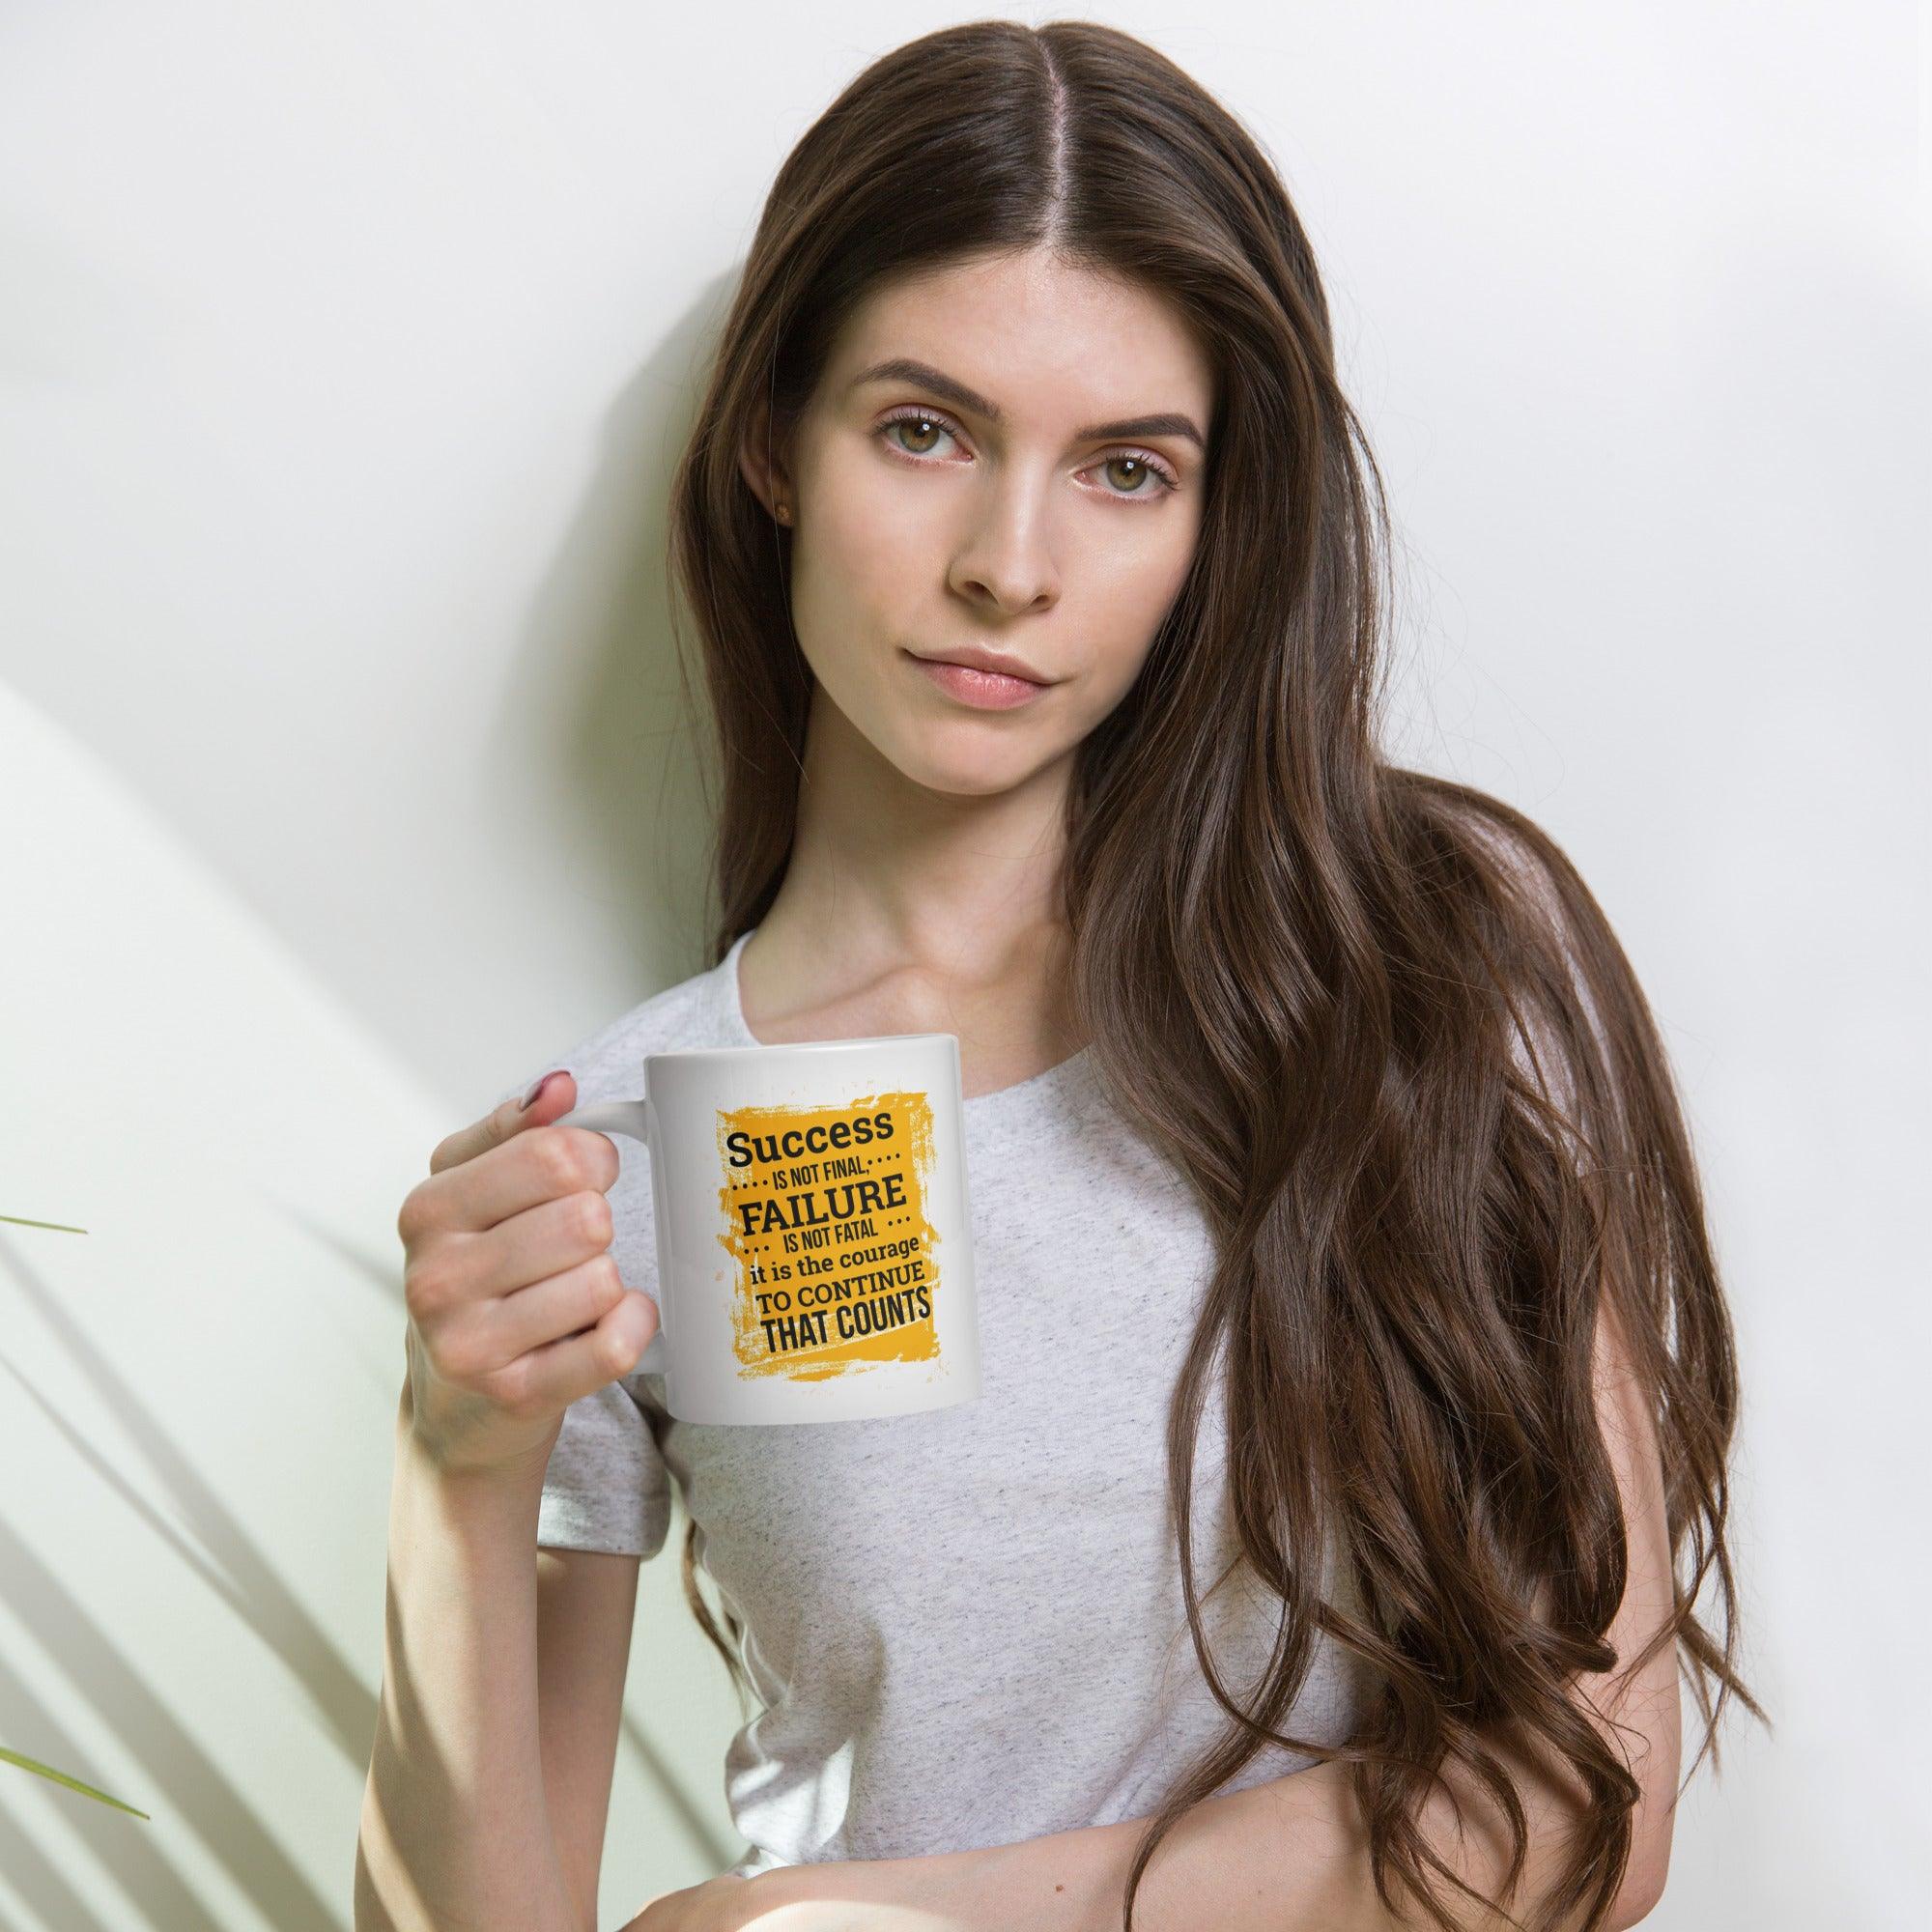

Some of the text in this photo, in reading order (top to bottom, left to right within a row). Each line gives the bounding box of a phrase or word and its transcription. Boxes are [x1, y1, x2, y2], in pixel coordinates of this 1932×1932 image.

[726, 1113, 895, 1168] Success
[773, 1155, 869, 1190] IS NOT FINAL,
[738, 1174, 907, 1236] FAILURE
[750, 1236, 920, 1285] it is the courage
[783, 1220, 878, 1254] IS NOT FATAL
[755, 1261, 925, 1315] TO CONTINUE
[760, 1286, 931, 1352] THAT COUNTS
